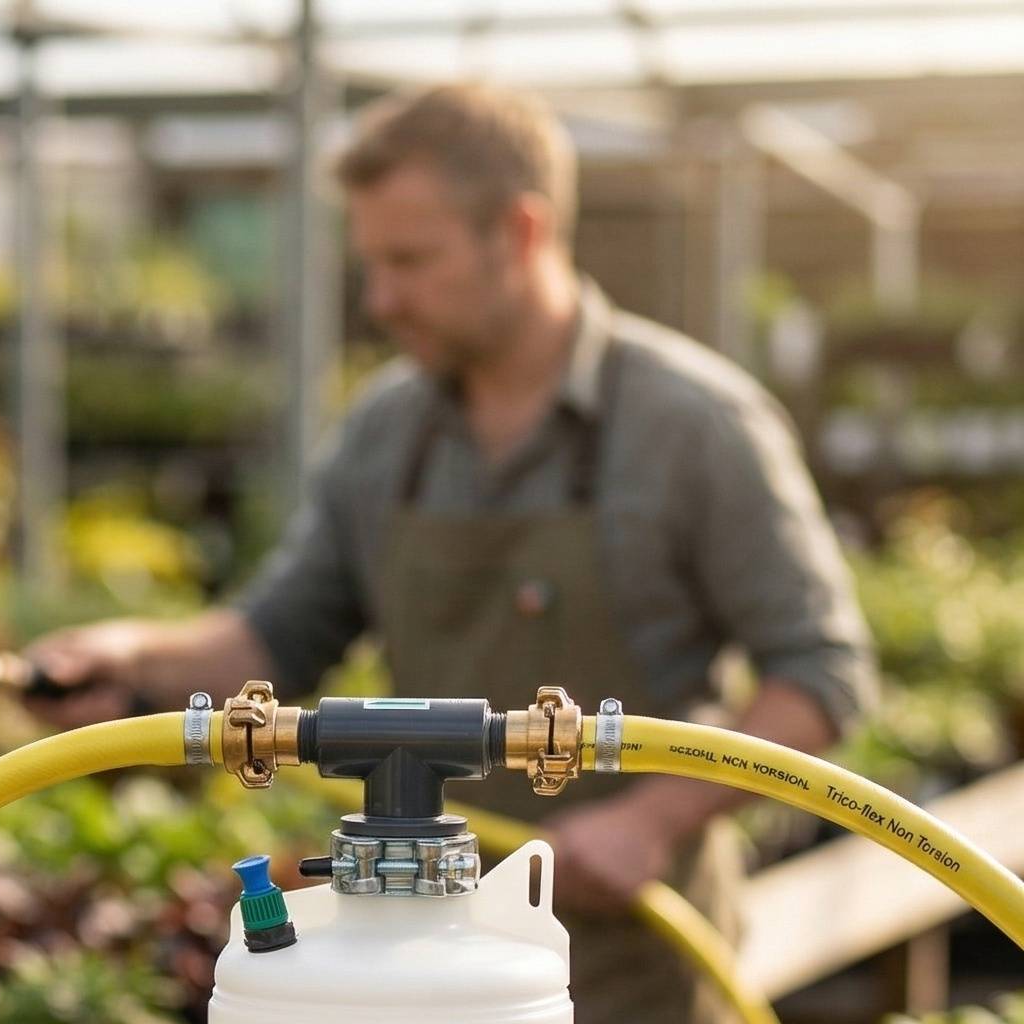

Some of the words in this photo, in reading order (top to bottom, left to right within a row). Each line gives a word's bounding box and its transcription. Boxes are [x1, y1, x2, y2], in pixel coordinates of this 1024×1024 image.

[826, 785, 885, 826] Trico-flex
[886, 818, 914, 843] Non
[917, 835, 960, 872] Torsion
